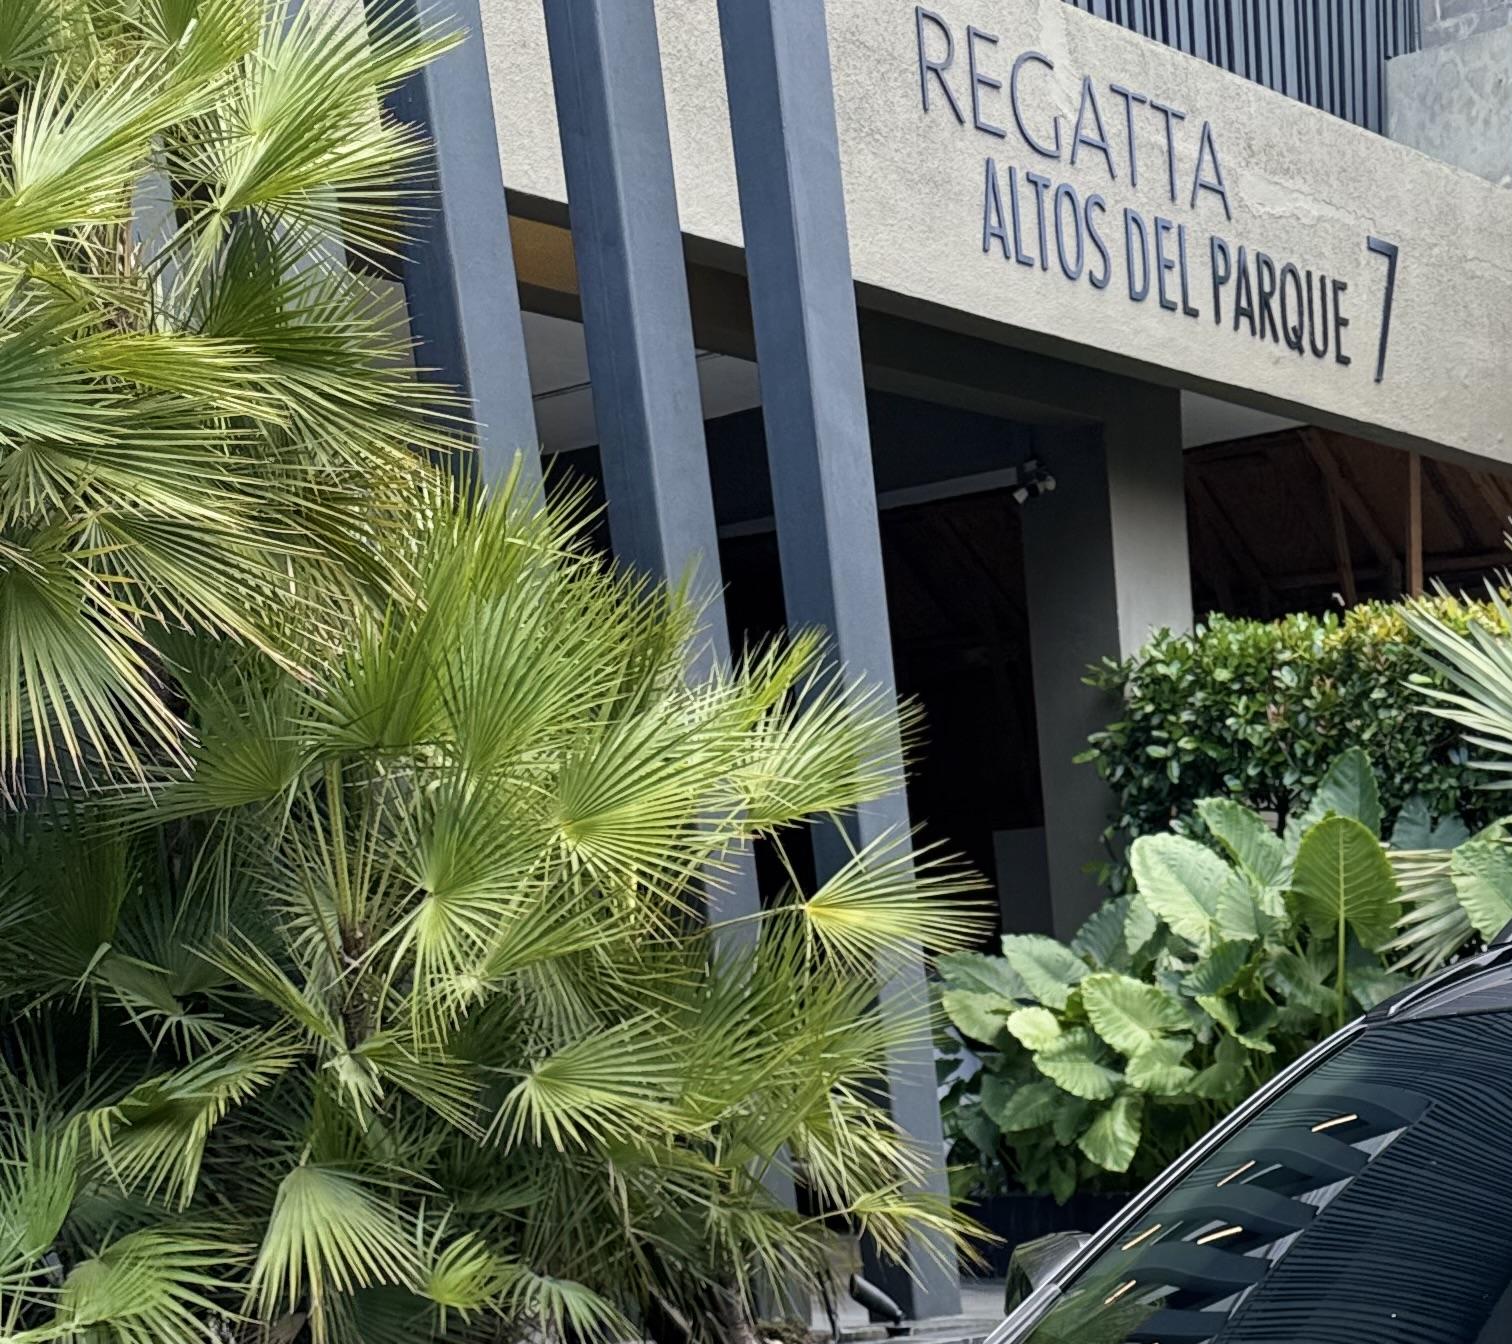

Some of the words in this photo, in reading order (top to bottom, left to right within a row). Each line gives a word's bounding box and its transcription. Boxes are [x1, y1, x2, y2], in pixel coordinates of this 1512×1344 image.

[915, 5, 1232, 221] REGATTA
[982, 156, 1112, 290] ALTOS
[1123, 207, 1200, 318] DEL
[1210, 234, 1352, 366] PARQUE
[1366, 234, 1399, 384] 7
